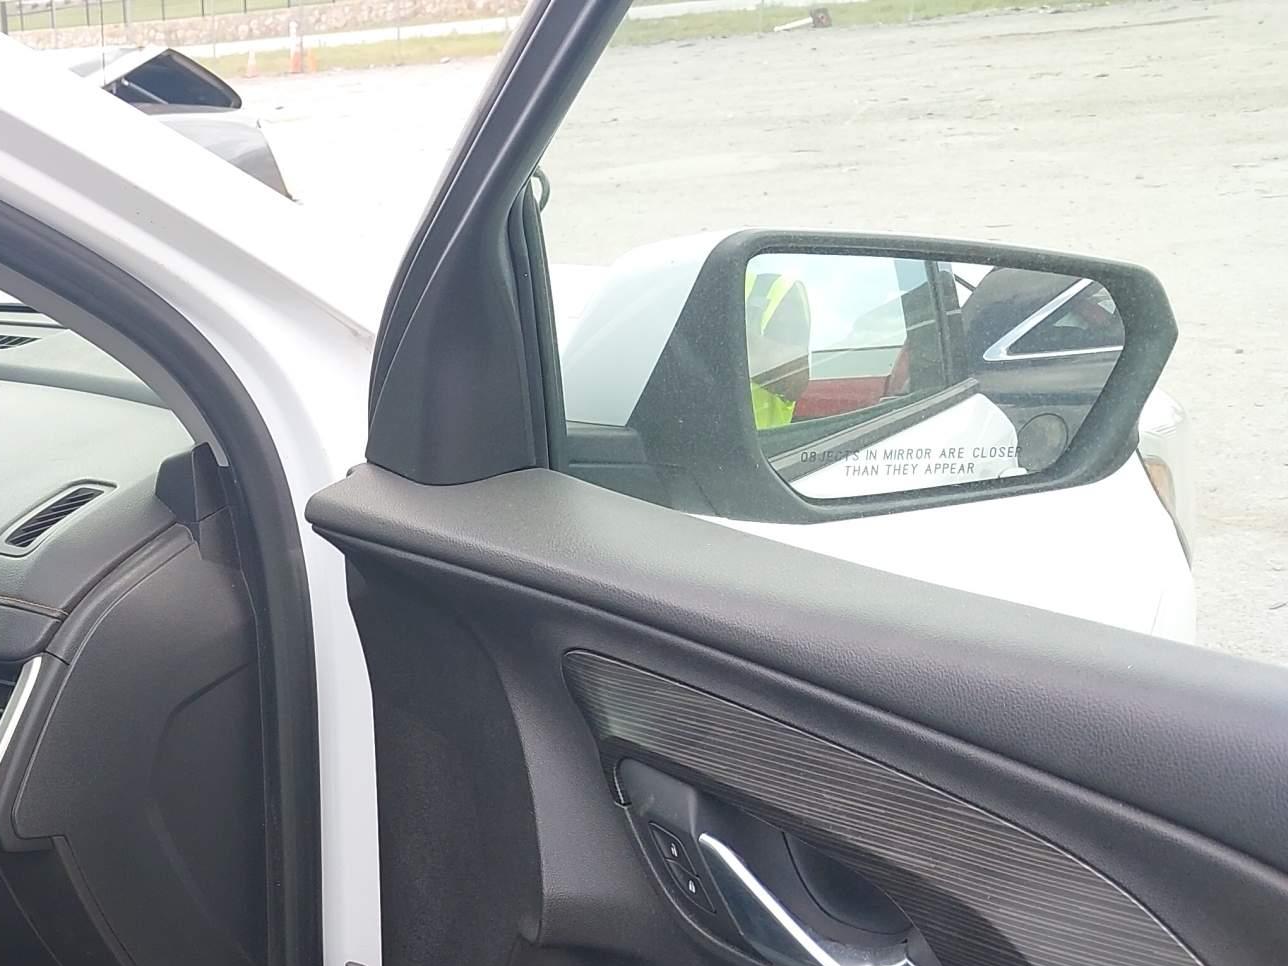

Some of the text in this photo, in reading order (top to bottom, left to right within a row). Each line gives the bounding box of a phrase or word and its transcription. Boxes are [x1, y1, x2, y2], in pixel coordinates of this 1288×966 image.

[801, 446, 1022, 463] OBJECTS IN MIRROR ARE CLOSER
[844, 462, 975, 477] THAN THEY APPEAR
